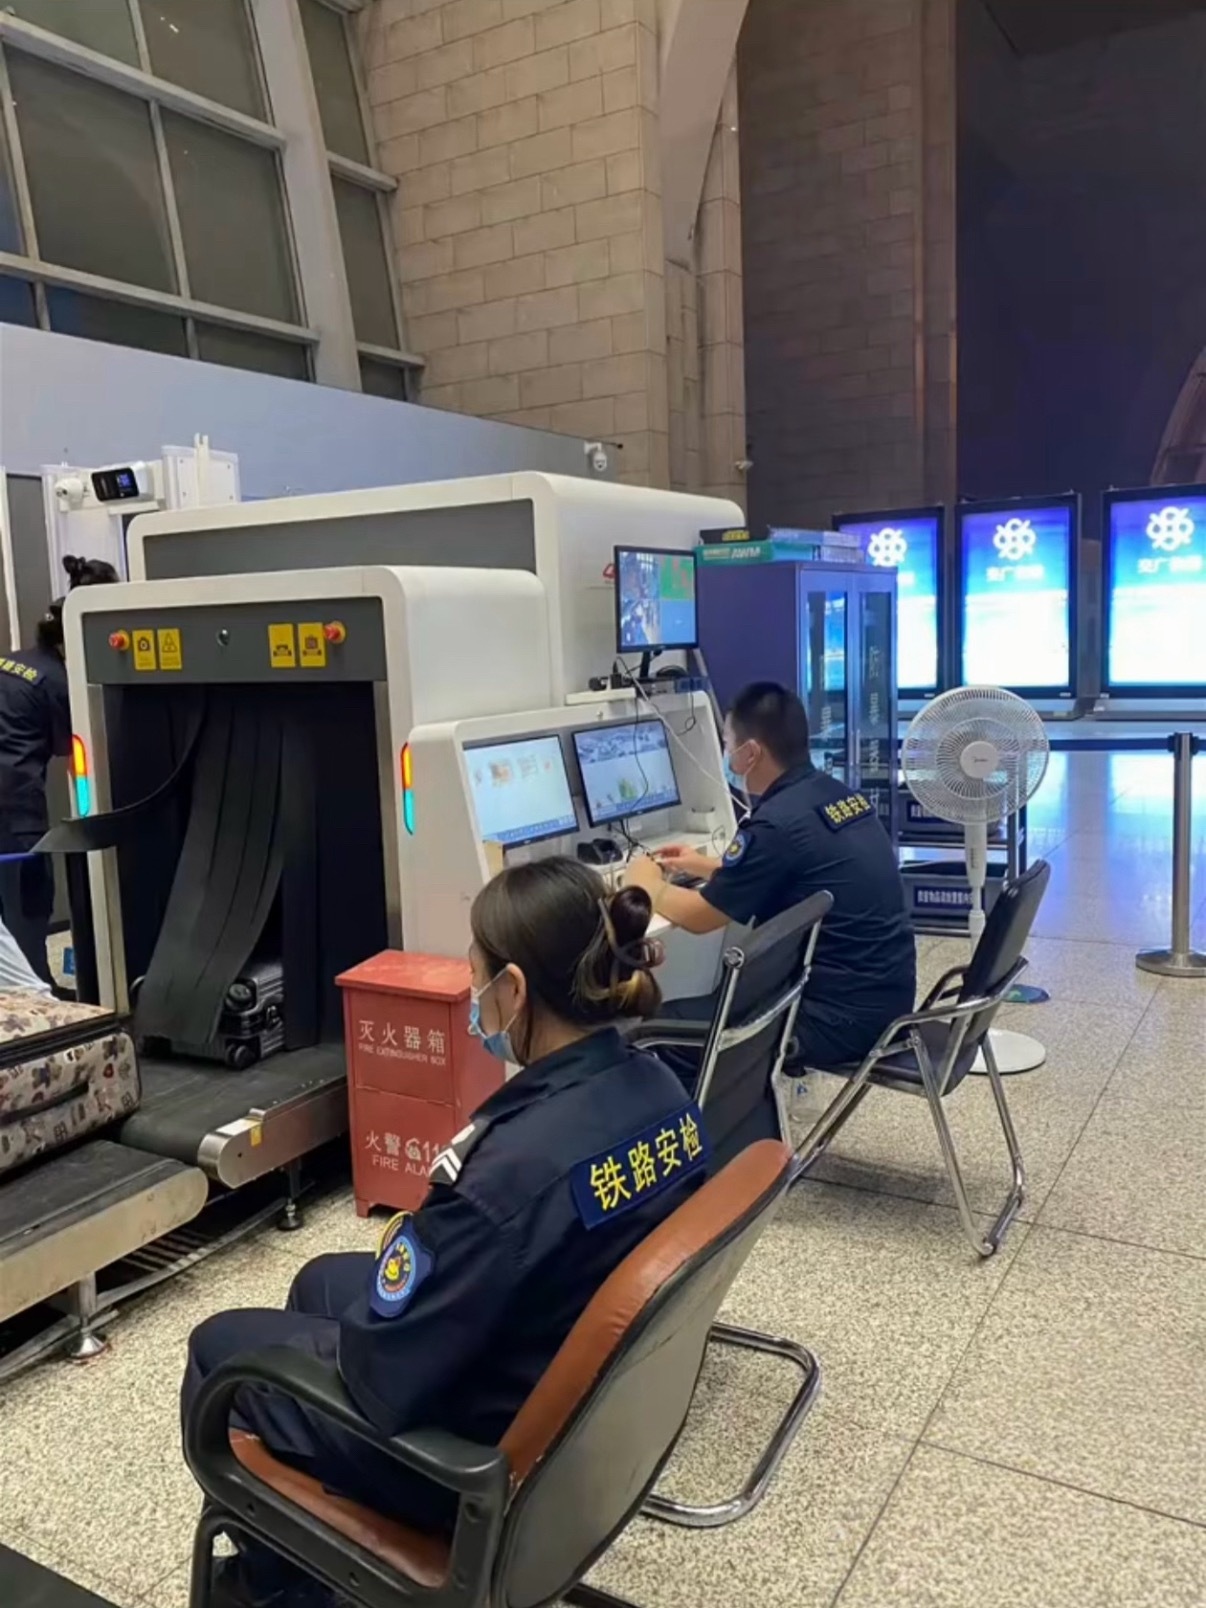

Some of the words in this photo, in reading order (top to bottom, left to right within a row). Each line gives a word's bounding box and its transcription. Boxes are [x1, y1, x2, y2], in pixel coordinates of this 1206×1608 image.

[358, 1019, 446, 1055] 灭火器箱
[358, 1042, 375, 1054] FIRE
[365, 1130, 401, 1156] 火警
[372, 1153, 399, 1171] FIRE
[404, 1161, 431, 1178] ALA
[590, 1112, 702, 1211] 铁路安检
